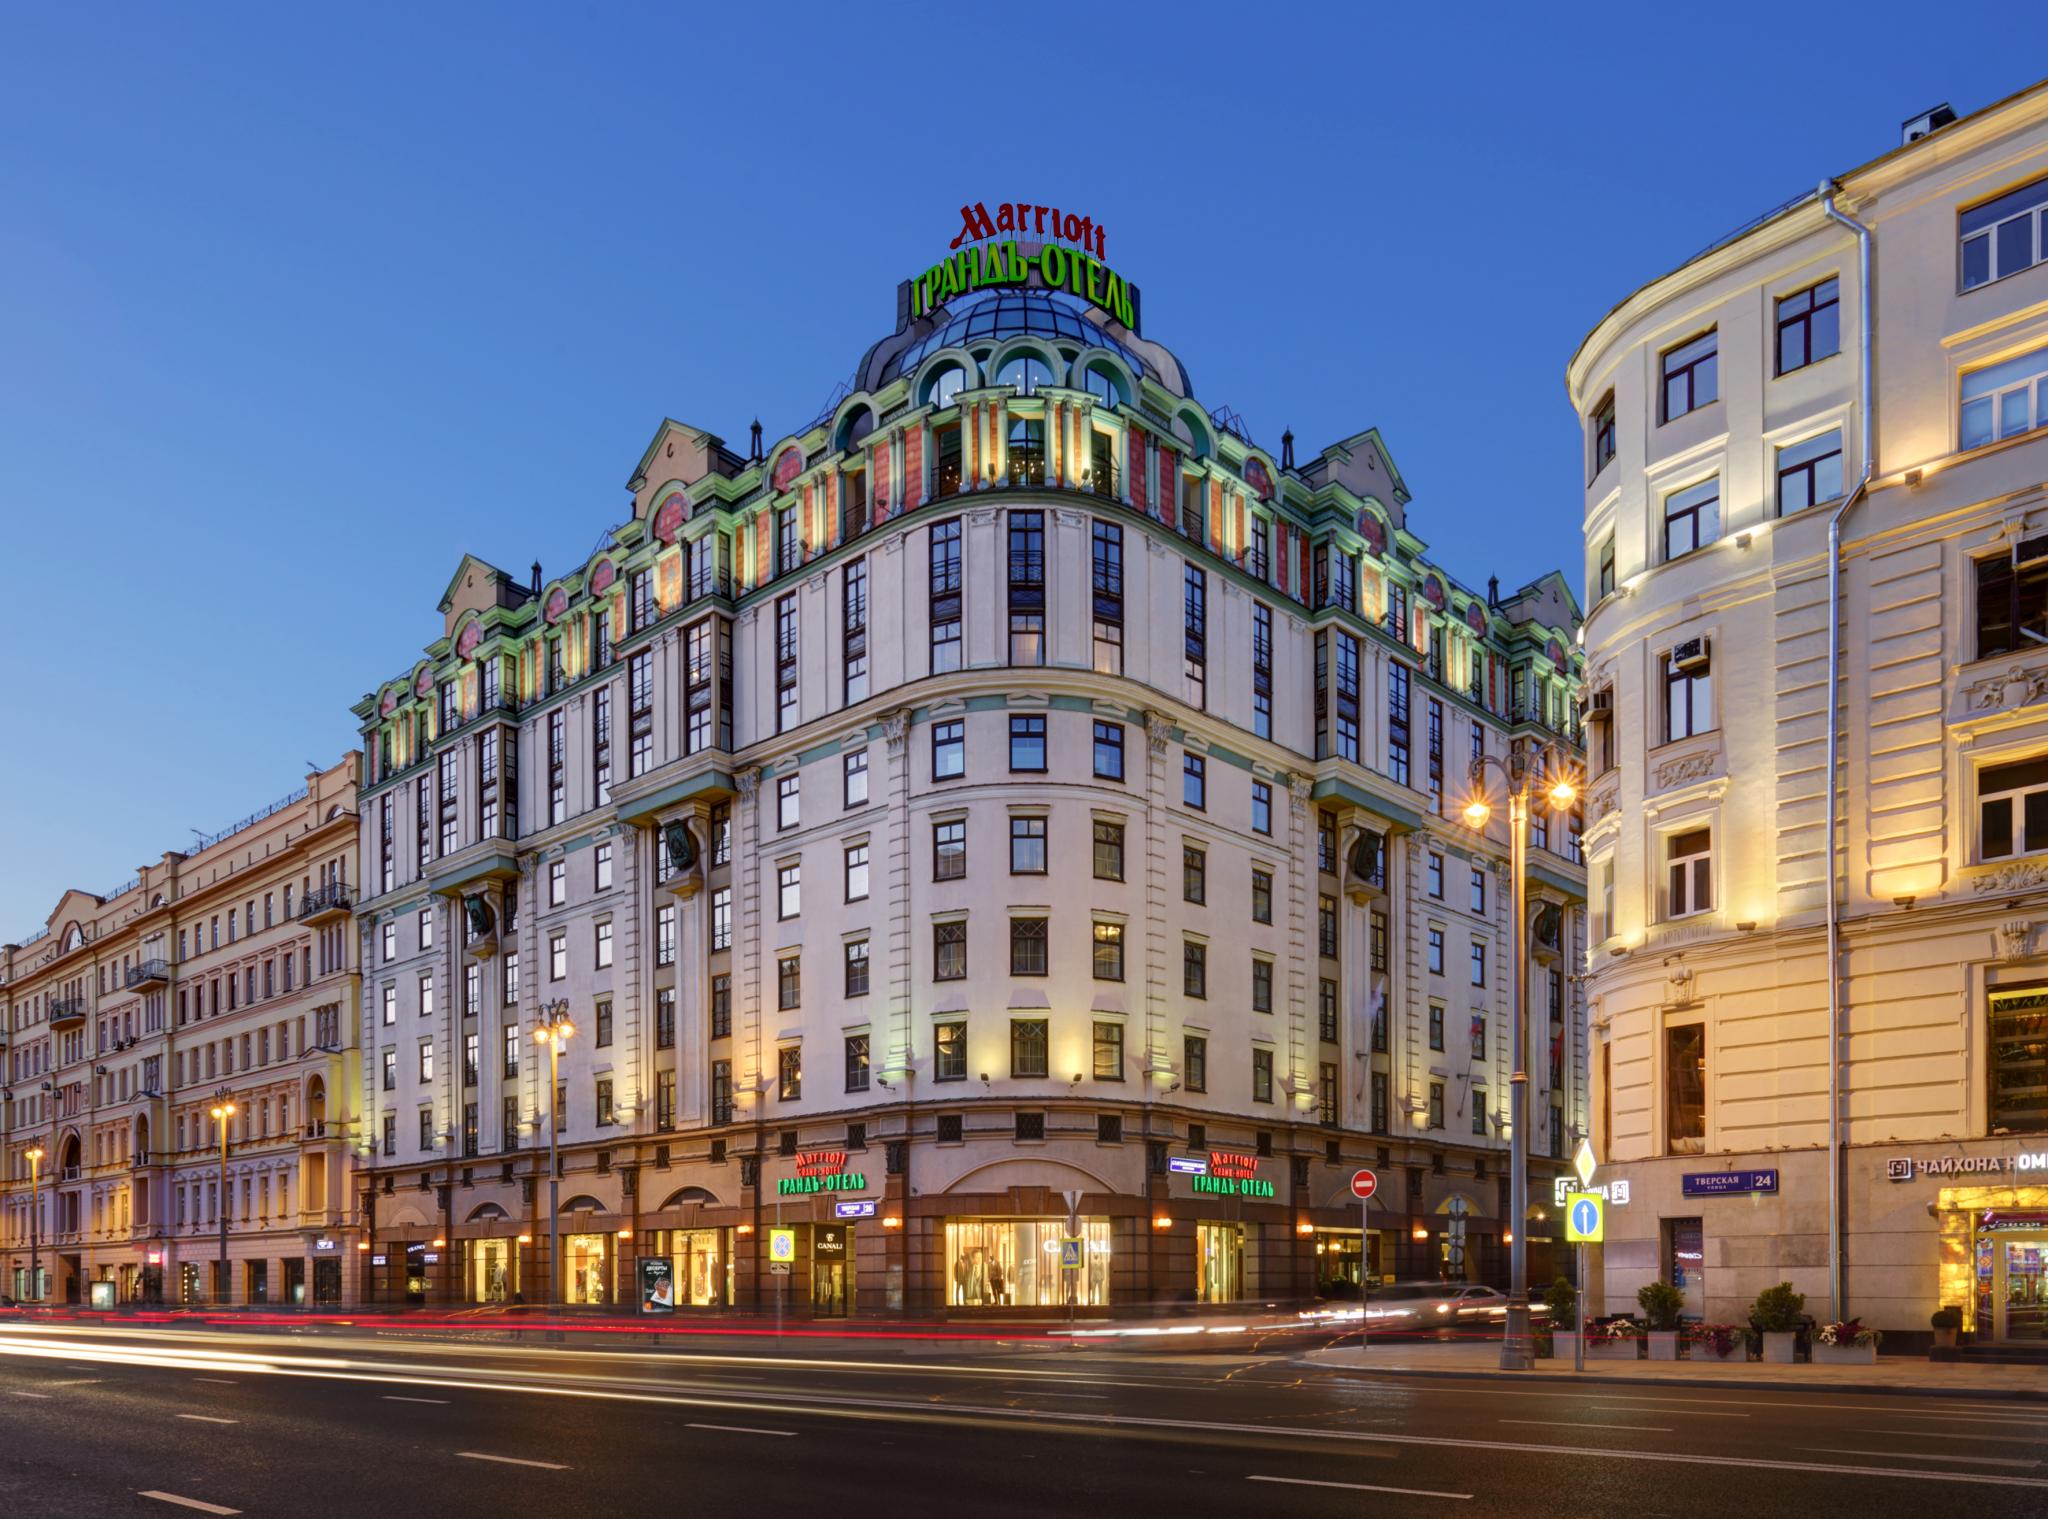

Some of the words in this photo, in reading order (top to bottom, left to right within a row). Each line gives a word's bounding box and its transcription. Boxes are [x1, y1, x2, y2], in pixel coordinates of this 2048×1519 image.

[950, 202, 1106, 261] Marriott
[912, 240, 1135, 330] ГРАНДЪ-ОТЕЛЬ
[795, 1152, 847, 1168] Marriott
[1210, 1151, 1258, 1171] Marriott
[1917, 1156, 2000, 1174] ЧАЙХОНА
[2006, 1153, 2048, 1170] НОМ
[777, 1173, 866, 1195] ГРАНДЪ-ОТЕЛЬ
[1193, 1175, 1275, 1198] ГРАНДЪ-ОТЕЛЬ
[1695, 1176, 1739, 1185] ТВЕРСКАЯ
[1755, 1175, 1771, 1187] 24
[817, 1242, 843, 1250] CANALI
